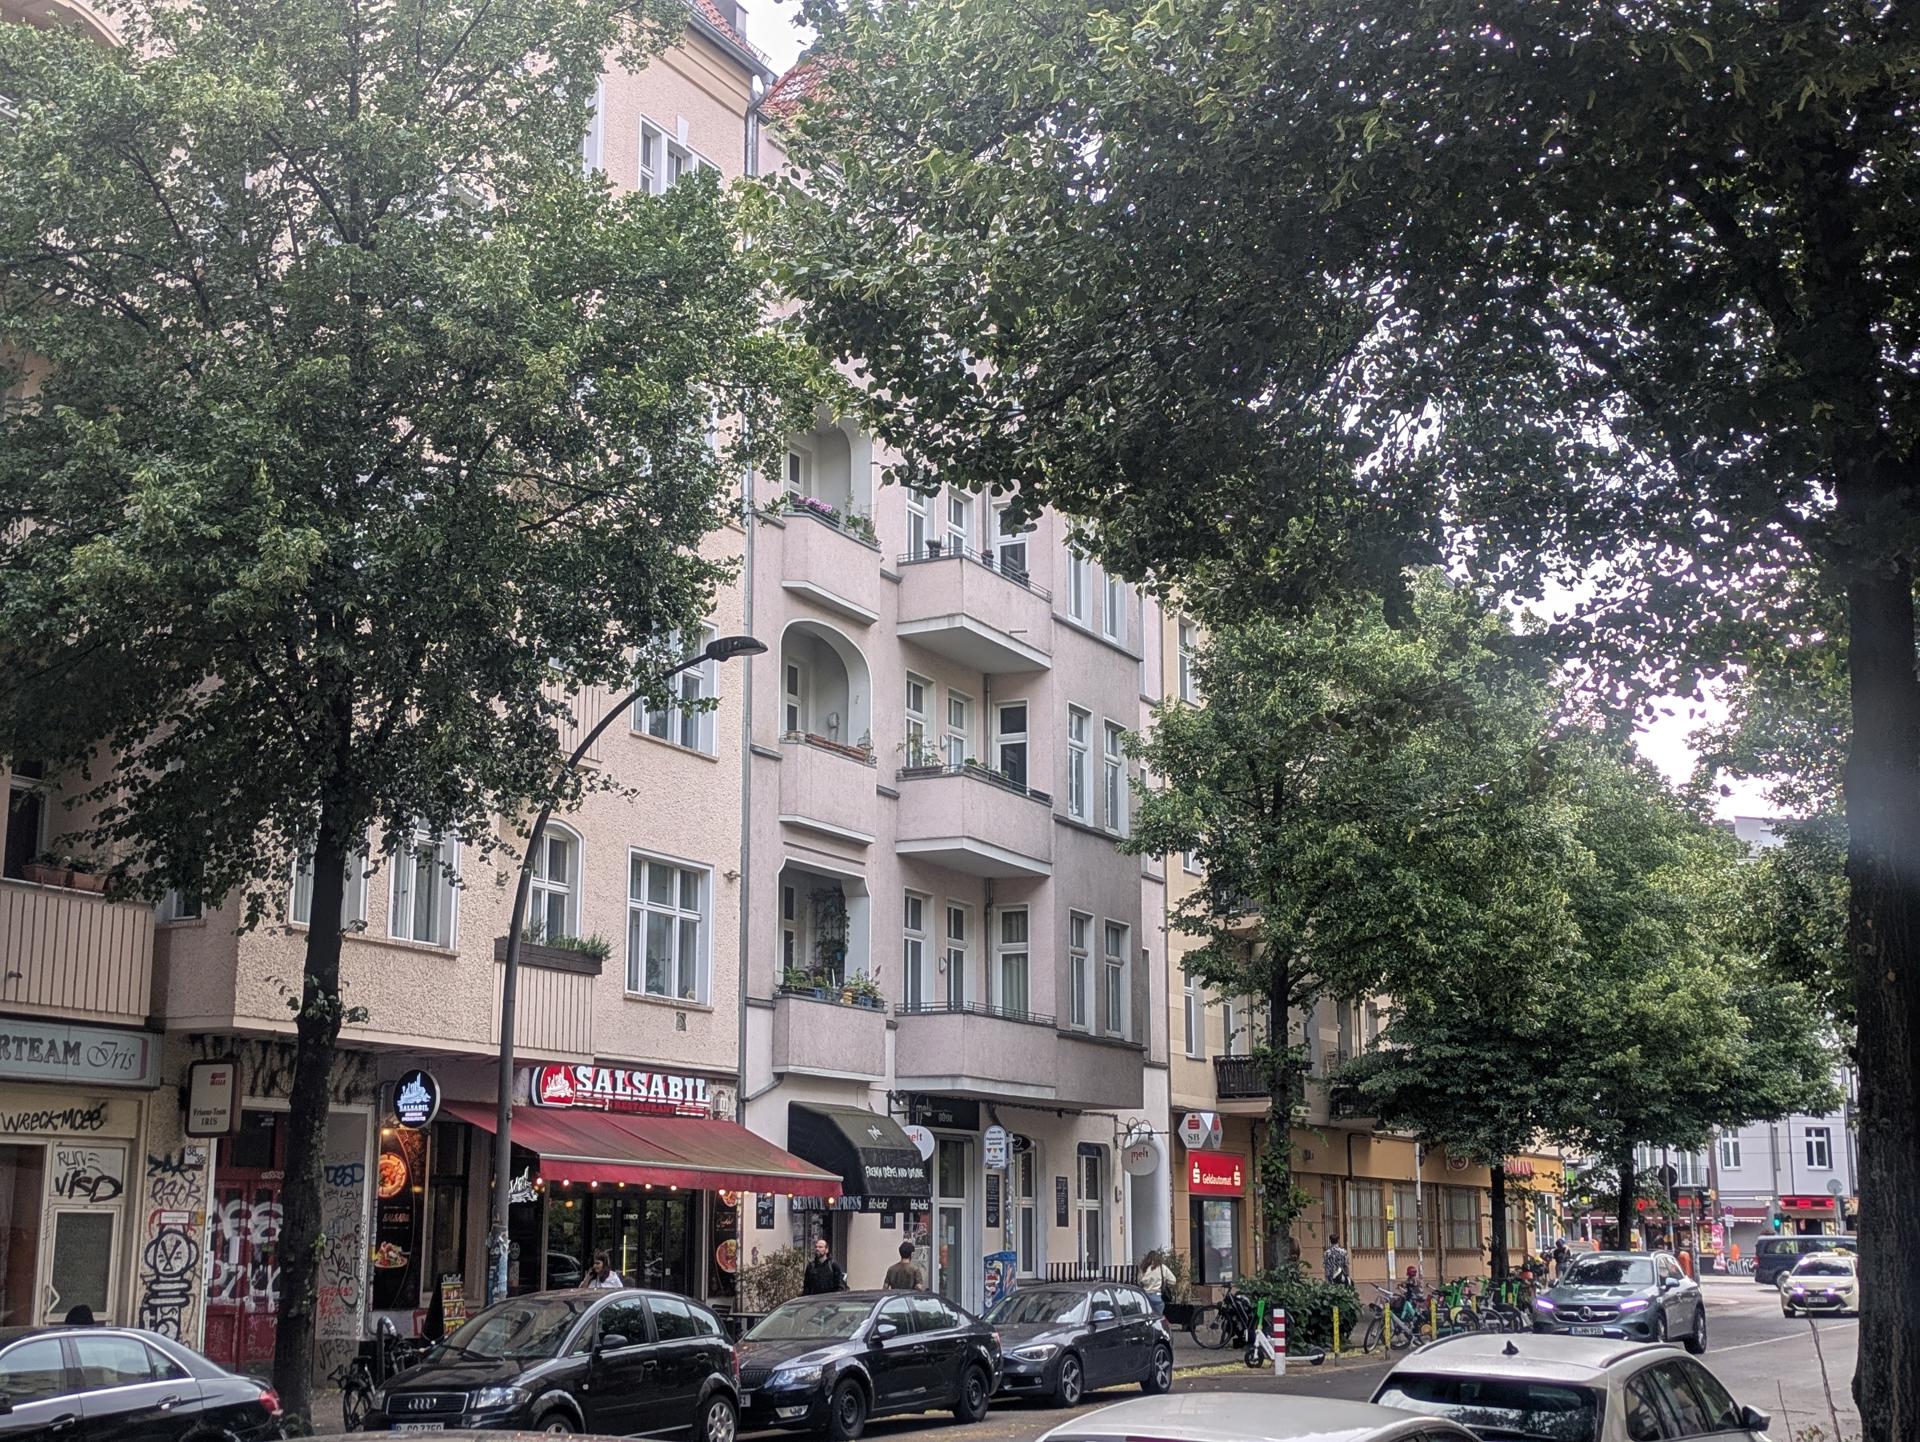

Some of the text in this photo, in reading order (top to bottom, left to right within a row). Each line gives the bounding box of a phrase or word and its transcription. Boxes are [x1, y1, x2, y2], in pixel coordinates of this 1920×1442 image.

[86, 1041, 136, 1070] Iris
[575, 1065, 711, 1103] SALSABIL
[613, 1101, 677, 1114] RESTAURANT
[1187, 1133, 1200, 1141] SB
[1202, 1173, 1232, 1185] Geldautomat
